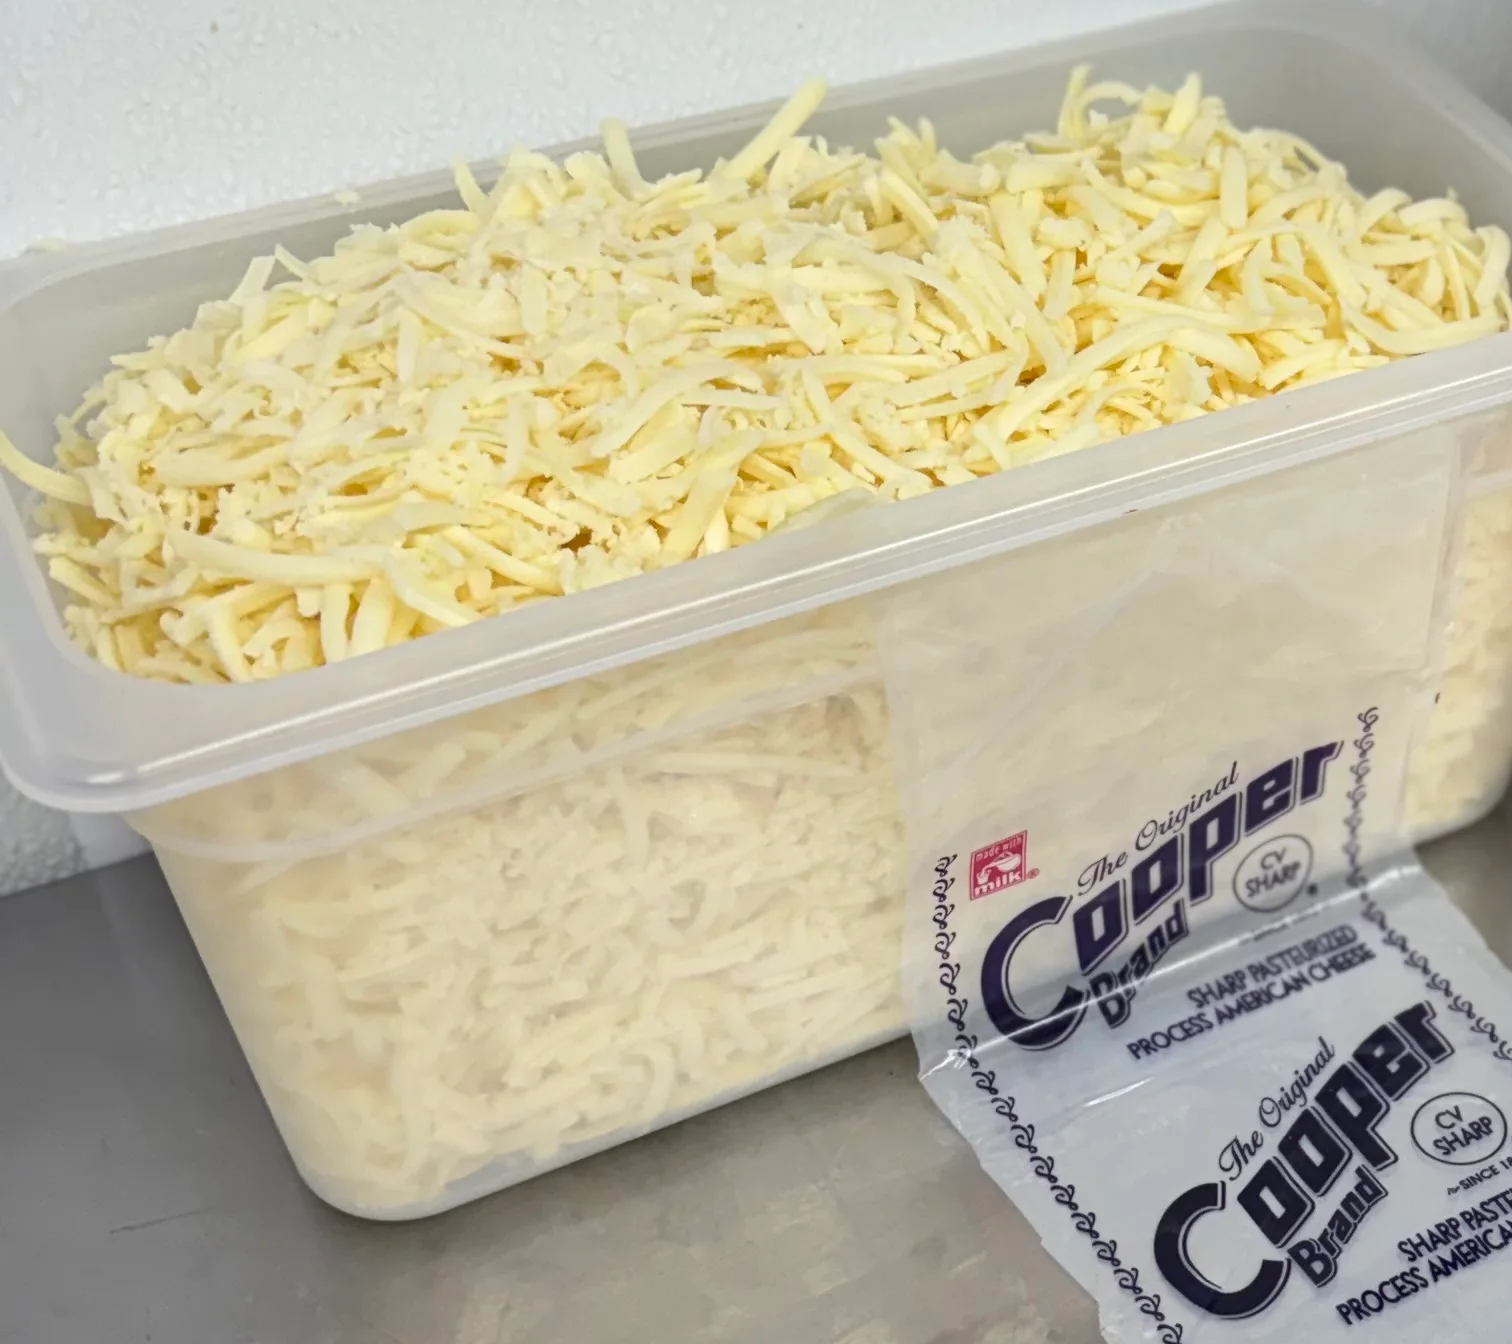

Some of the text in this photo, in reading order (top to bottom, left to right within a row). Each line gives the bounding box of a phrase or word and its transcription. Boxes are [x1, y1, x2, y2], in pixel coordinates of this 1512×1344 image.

[1077, 761, 1239, 896] The Original
[1260, 847, 1287, 871] CV
[974, 870, 1022, 896] milk
[980, 739, 1344, 1051] Cooper
[1245, 861, 1301, 898] SHARP
[1089, 899, 1189, 1030] Brand
[1187, 970, 1247, 1008] SHARP
[1247, 924, 1358, 983] PASTEURIZED
[1126, 942, 1377, 1060] PROCESS AMERICAN CHEESE
[1217, 1036, 1336, 1181] The Original
[1432, 1116, 1494, 1156] SHARP
[1434, 1105, 1464, 1129] CV
[1154, 1000, 1455, 1320] Cooper
[1459, 1164, 1500, 1191] SINCE
[1287, 1164, 1389, 1288] Brand
[1397, 1217, 1463, 1262] SHARP
[1335, 1266, 1429, 1325] PROCESS
